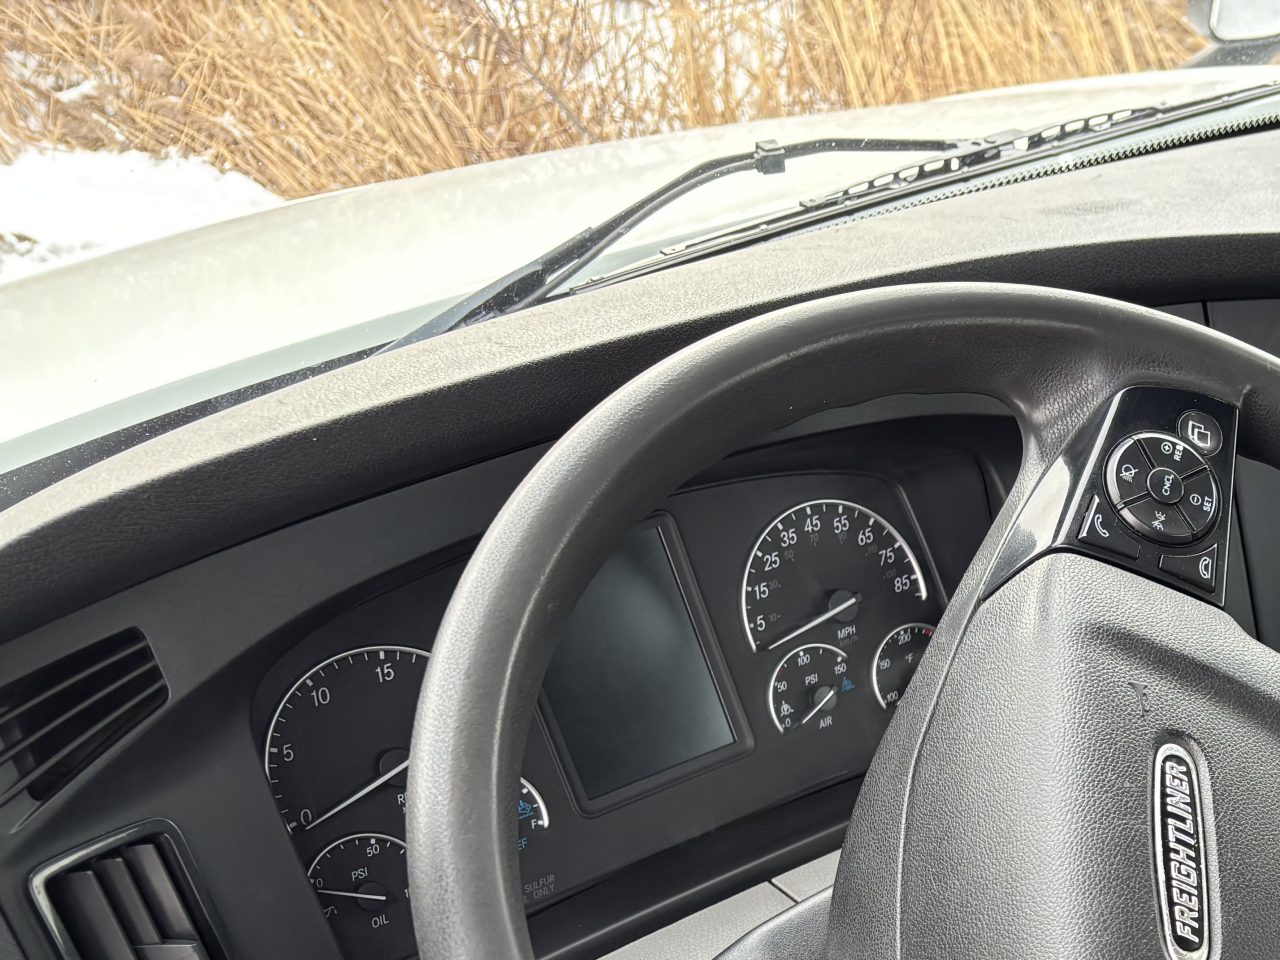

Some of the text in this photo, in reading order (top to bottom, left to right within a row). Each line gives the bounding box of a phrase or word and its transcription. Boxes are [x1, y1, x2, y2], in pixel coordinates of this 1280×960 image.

[1173, 443, 1185, 462] RES
[1161, 473, 1175, 496] CNCL
[1202, 496, 1213, 512] SET
[804, 515, 821, 533] 45
[833, 515, 850, 533] 55
[780, 528, 797, 548] 35
[857, 527, 874, 546] 65
[763, 552, 780, 571] 25
[878, 548, 895, 567] 75
[754, 582, 769, 600] 15
[894, 575, 910, 593] 85
[756, 614, 766, 631] 5
[837, 626, 857, 640] MPH
[797, 654, 810, 667] 100
[834, 662, 847, 675] 150
[375, 663, 395, 683] 15
[805, 673, 818, 686] PSI
[777, 680, 788, 693] 50
[310, 687, 330, 707] 10
[785, 717, 791, 727] 0
[819, 715, 833, 730] AIR
[282, 743, 295, 762] 5
[300, 808, 313, 826] 0
[531, 819, 537, 830] F
[366, 843, 380, 857] 50
[1165, 760, 1200, 944] FREIGHTLINER
[316, 877, 324, 888] 0
[351, 866, 368, 882] PSI
[524, 874, 555, 893] SULFUR
[533, 884, 555, 899] ONLY
[371, 915, 390, 928] OIL
